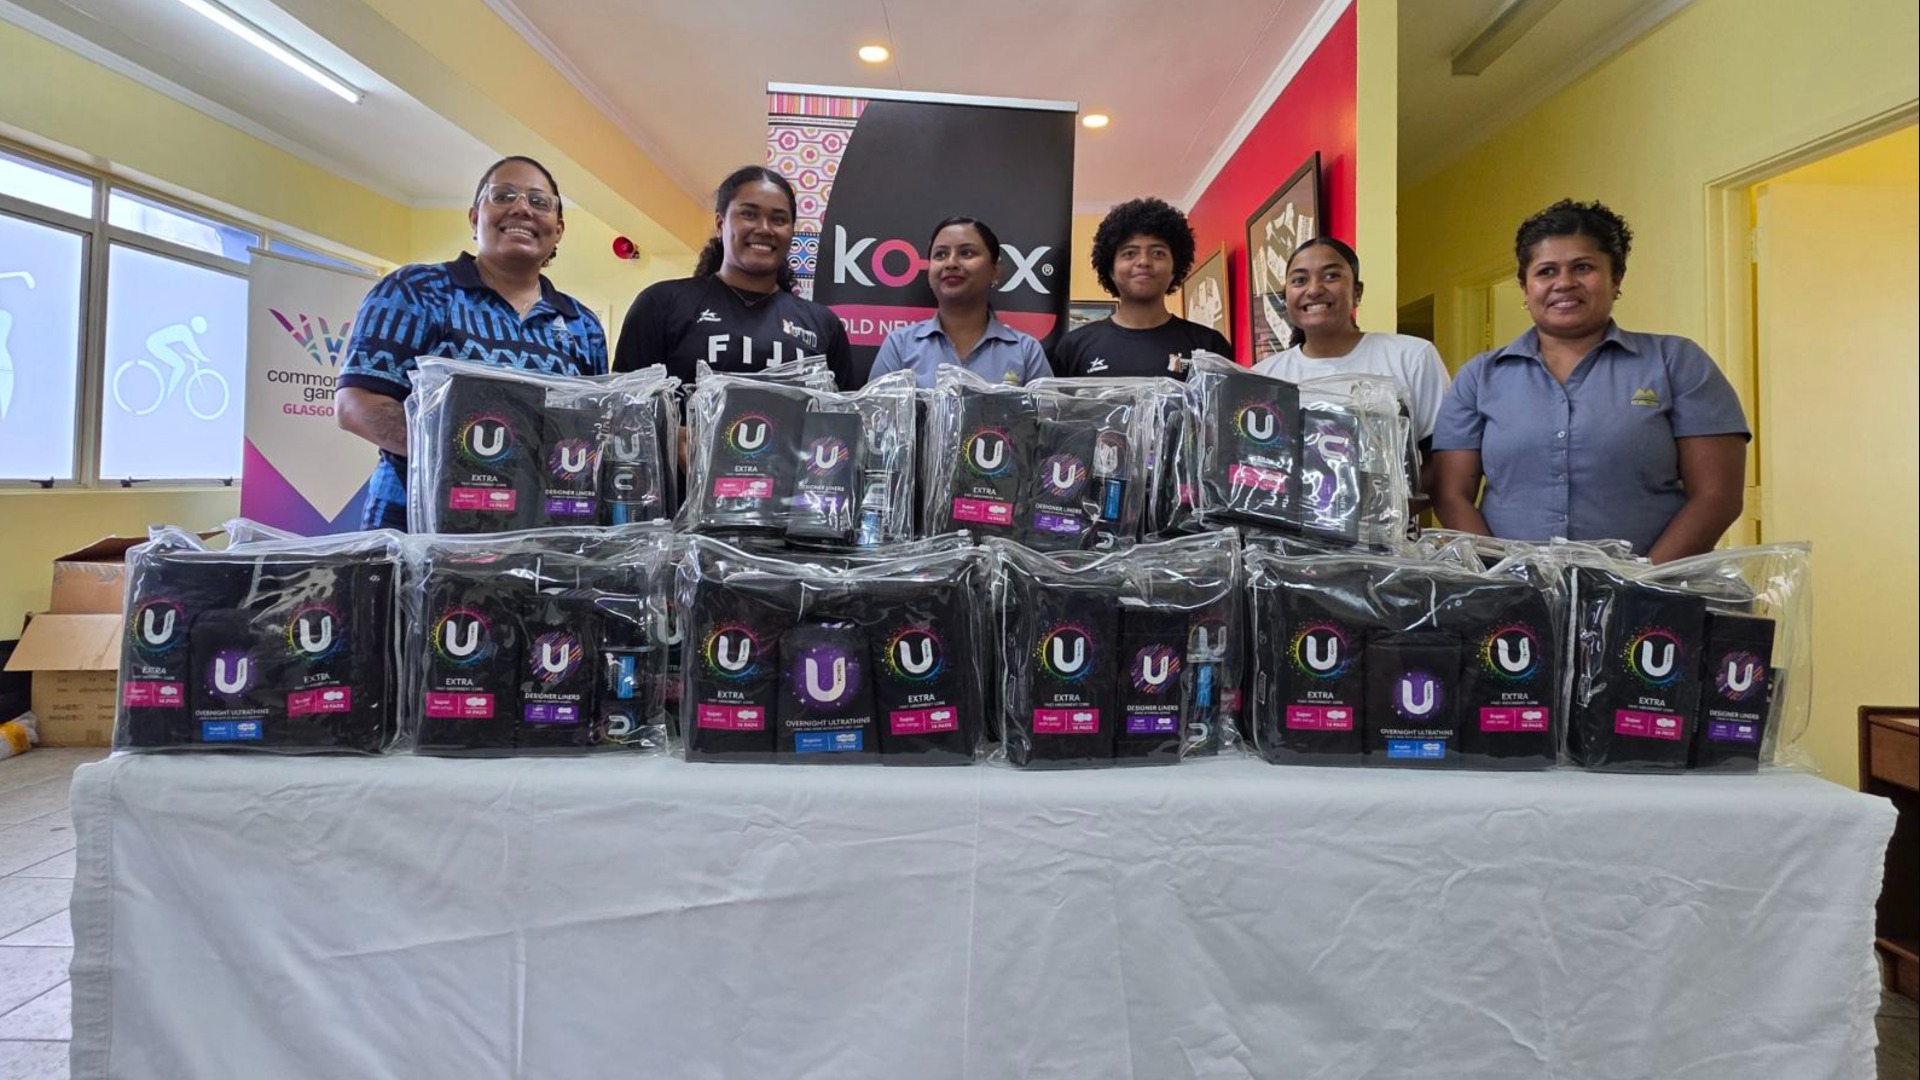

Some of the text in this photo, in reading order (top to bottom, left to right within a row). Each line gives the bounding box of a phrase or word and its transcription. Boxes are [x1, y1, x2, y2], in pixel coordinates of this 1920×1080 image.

[708, 334, 804, 371] FIJI
[283, 403, 335, 417] GLASGO
[738, 423, 767, 450] U
[1247, 410, 1273, 440] U
[473, 425, 505, 456] U
[975, 438, 1003, 469] U
[561, 447, 586, 473] U
[735, 465, 758, 473] EXTRA
[815, 445, 839, 469] U
[472, 474, 498, 482] EXTRA
[1052, 462, 1077, 489] U
[973, 486, 997, 496] EXTRA
[144, 609, 175, 645] U
[300, 615, 332, 652] U
[446, 620, 479, 656] U
[542, 643, 570, 673] U
[718, 635, 750, 671] U
[899, 637, 934, 674] U
[1053, 636, 1084, 673] U
[1306, 635, 1338, 671] U
[1497, 637, 1531, 672] U
[1642, 640, 1675, 677] U
[214, 657, 248, 694] U
[445, 678, 474, 686] EXTRA
[805, 657, 846, 702] U
[1143, 655, 1169, 685] U
[1727, 661, 1753, 692] U
[525, 692, 581, 701] DESIGNER LINERS
[717, 690, 745, 700] EXTRA
[908, 693, 936, 704] EXTRA
[1054, 693, 1080, 702] EXTRA
[1126, 704, 1178, 712] DESIGNER LINERS
[1307, 691, 1334, 700] EXTRA
[1402, 680, 1434, 715] U
[1501, 692, 1529, 701] EXTRA
[1639, 696, 1666, 707] EXTRA
[195, 708, 270, 717] OVERNIGHT ULTRATHINS
[785, 719, 827, 728] OVERNIGHT
[828, 716, 871, 726] ULTRATHINS
[1709, 709, 1739, 718] DESIGNER
[1739, 712, 1759, 720] LINERS
[1380, 728, 1454, 737] OVERNIGHT ULTRATHINS
